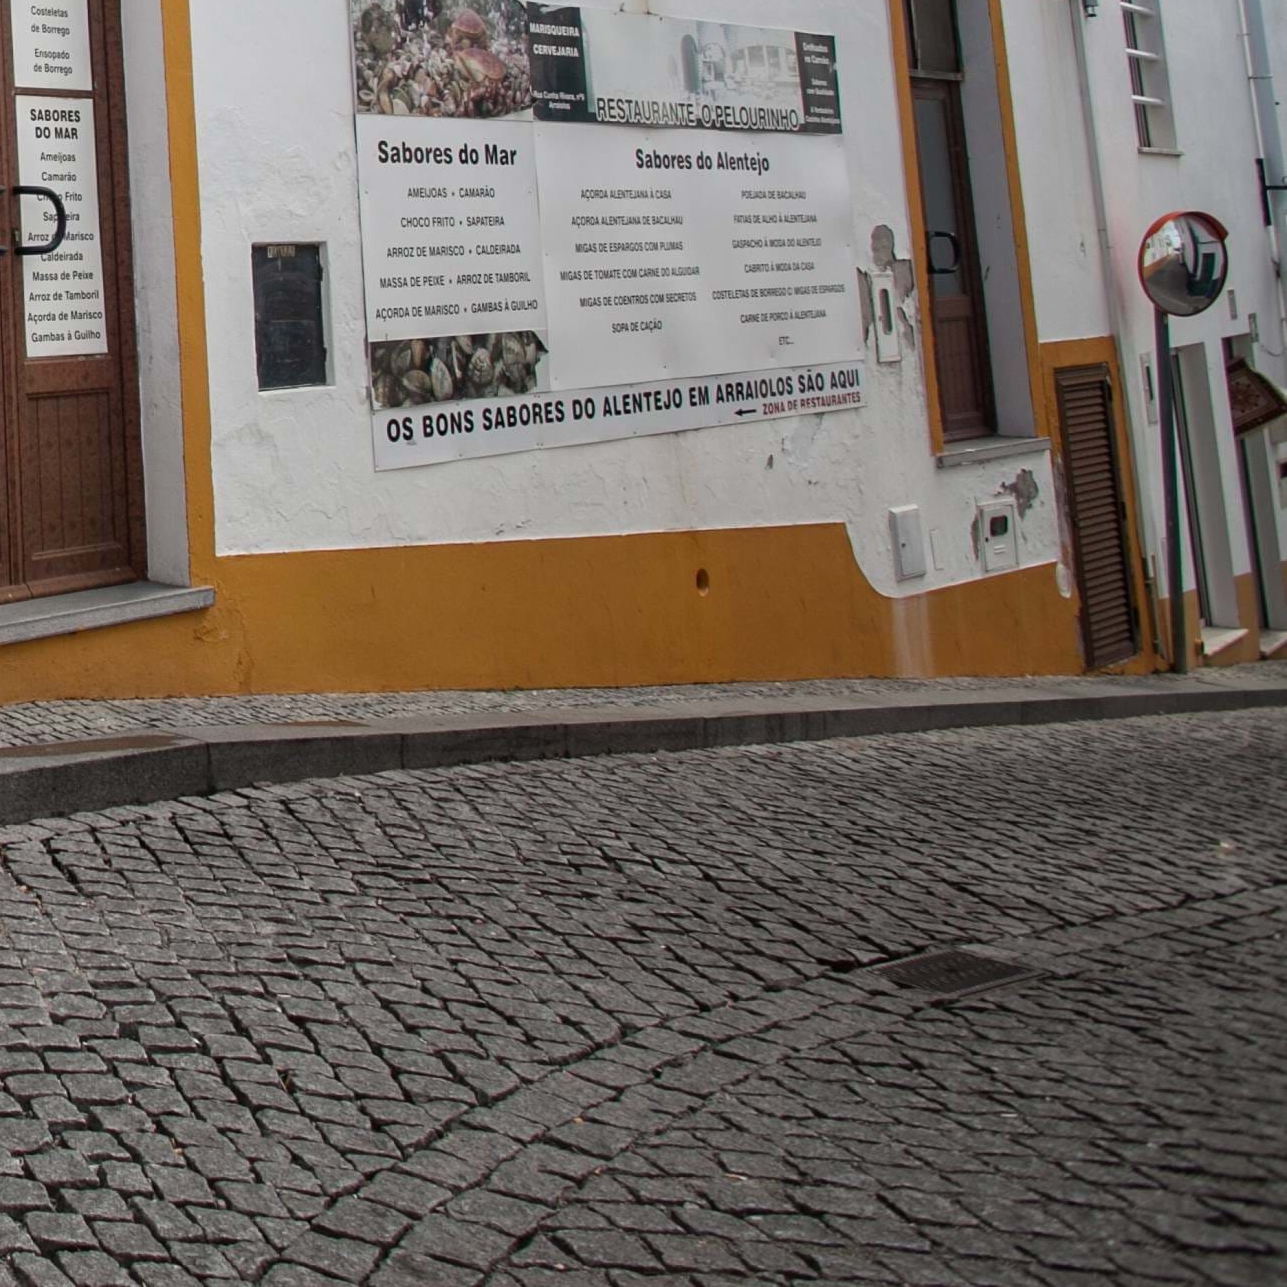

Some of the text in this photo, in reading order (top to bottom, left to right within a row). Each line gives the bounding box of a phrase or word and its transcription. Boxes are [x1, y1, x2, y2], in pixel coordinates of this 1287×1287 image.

[31, 5, 68, 18] Costeletas
[41, 24, 70, 37] Borrego
[529, 23, 580, 37] MARISQUEIRA
[34, 48, 70, 60] Ensopado
[533, 44, 579, 57] CERVEJARIA
[44, 63, 73, 76] Borrego
[30, 109, 81, 122] SABORES
[596, 98, 695, 126] RESTAURANTE
[716, 105, 798, 130] PELOURINHO
[35, 126, 78, 139] DO MAR
[40, 151, 76, 165] Ameijoas
[378, 140, 517, 165] Sabores do Mar
[635, 148, 770, 175] Sabores do Alentejo
[41, 171, 76, 181] Camarão
[407, 185, 495, 198] AMEIJOAS CAMARÃO
[610, 189, 648, 199] ALENTEJANA
[43, 211, 80, 223] Sapeira
[401, 216, 505, 228] CHOCO FRITO SAPATEIRA
[601, 215, 683, 225] ALENTEJANA BACALHAU
[28, 232, 50, 241] Arroz
[387, 244, 520, 258] ARROZ DE MARISCO CALDEIRADA
[609, 242, 643, 252] ESPARGOS
[40, 251, 83, 261] Caldeirada
[32, 270, 93, 281] Massa de Peixe
[380, 272, 530, 289] MASSA DE PEIXE ARROZ TAMBORIL
[560, 269, 621, 281] MIGAS TOMATE
[29, 289, 99, 301] Arroz de Tamboril
[580, 294, 649, 307] MIGAS COENTROS
[376, 299, 538, 322] AÇORDA DE MARISCO GAMBAS GUILHO
[28, 310, 102, 325] Açorda de Marisco
[31, 330, 101, 342] Gambas Guilho
[387, 368, 860, 443] OS BONS SABORES DO ALENTEJO EM ARRAIOLOS SÃO AQUI
[762, 391, 861, 415] ZONA DE RESTAURANTES
